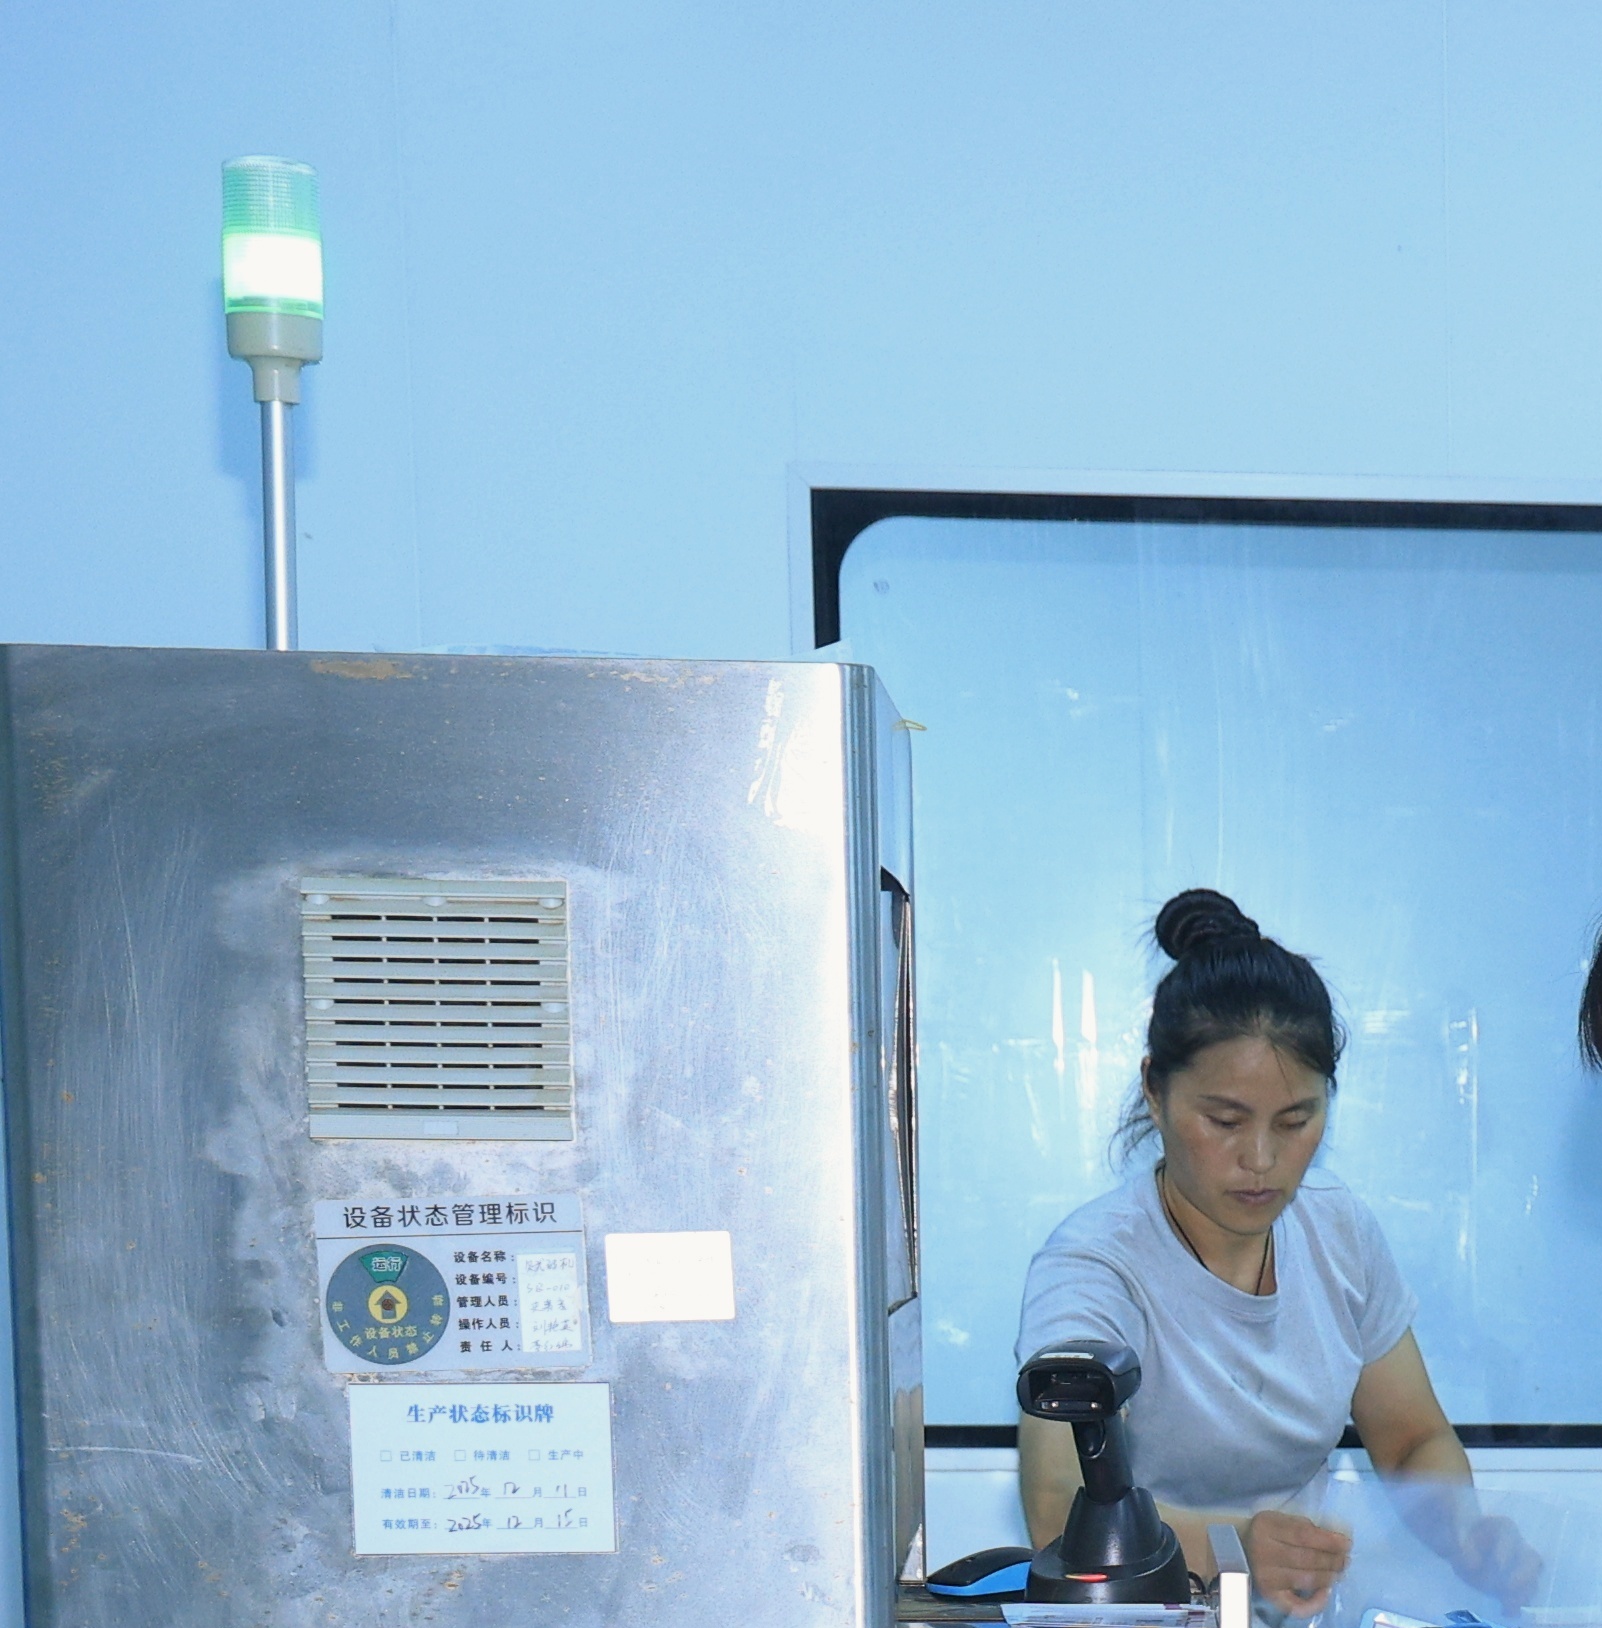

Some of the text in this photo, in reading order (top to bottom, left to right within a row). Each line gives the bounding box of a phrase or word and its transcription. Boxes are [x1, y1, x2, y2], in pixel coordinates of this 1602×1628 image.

[343, 1201, 557, 1229] 设备状态管理标识
[371, 1256, 402, 1273] 运行
[364, 1325, 418, 1341] 设备状态
[406, 1403, 554, 1424] 生产状态标识牌
[399, 1449, 584, 1462] 已清洁 待清洁 生产中
